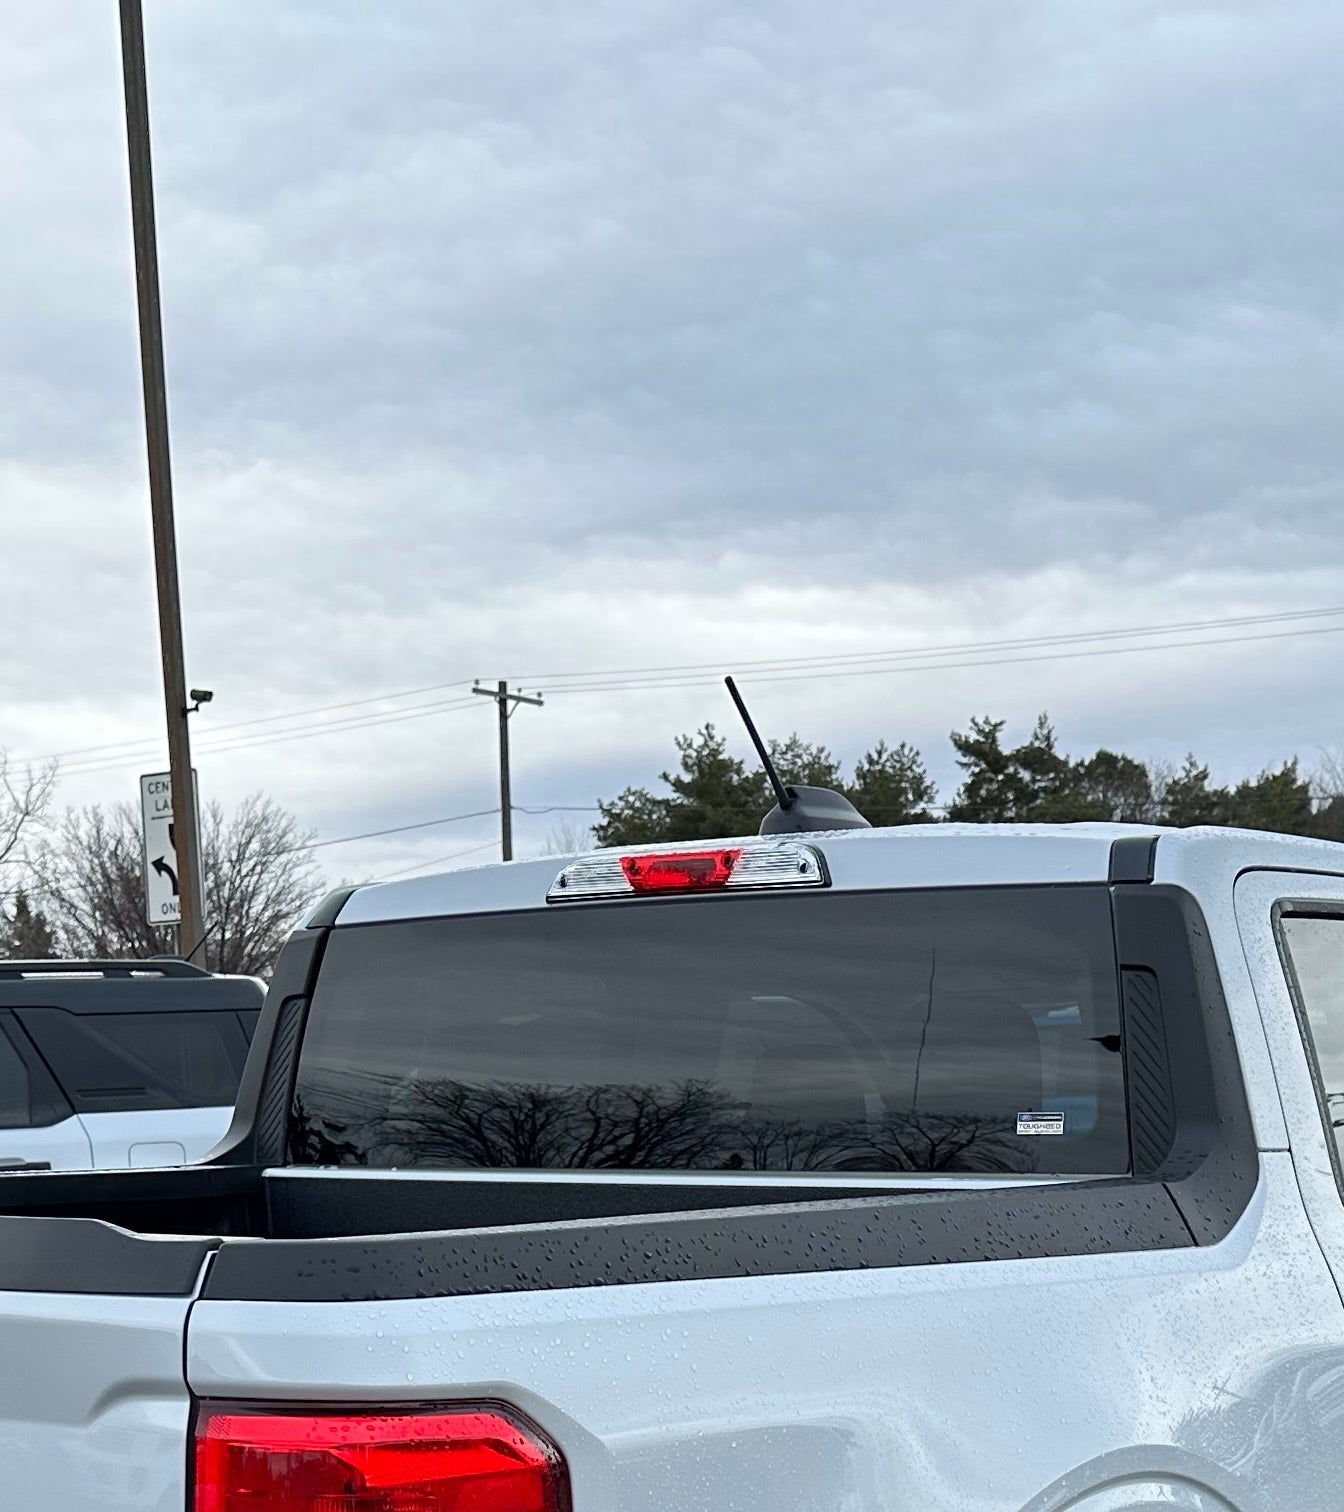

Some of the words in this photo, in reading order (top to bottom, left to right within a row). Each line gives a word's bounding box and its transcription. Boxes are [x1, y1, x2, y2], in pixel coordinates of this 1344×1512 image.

[148, 781, 171, 795] CEN
[155, 799, 172, 812] LA
[161, 902, 182, 915] ONL
